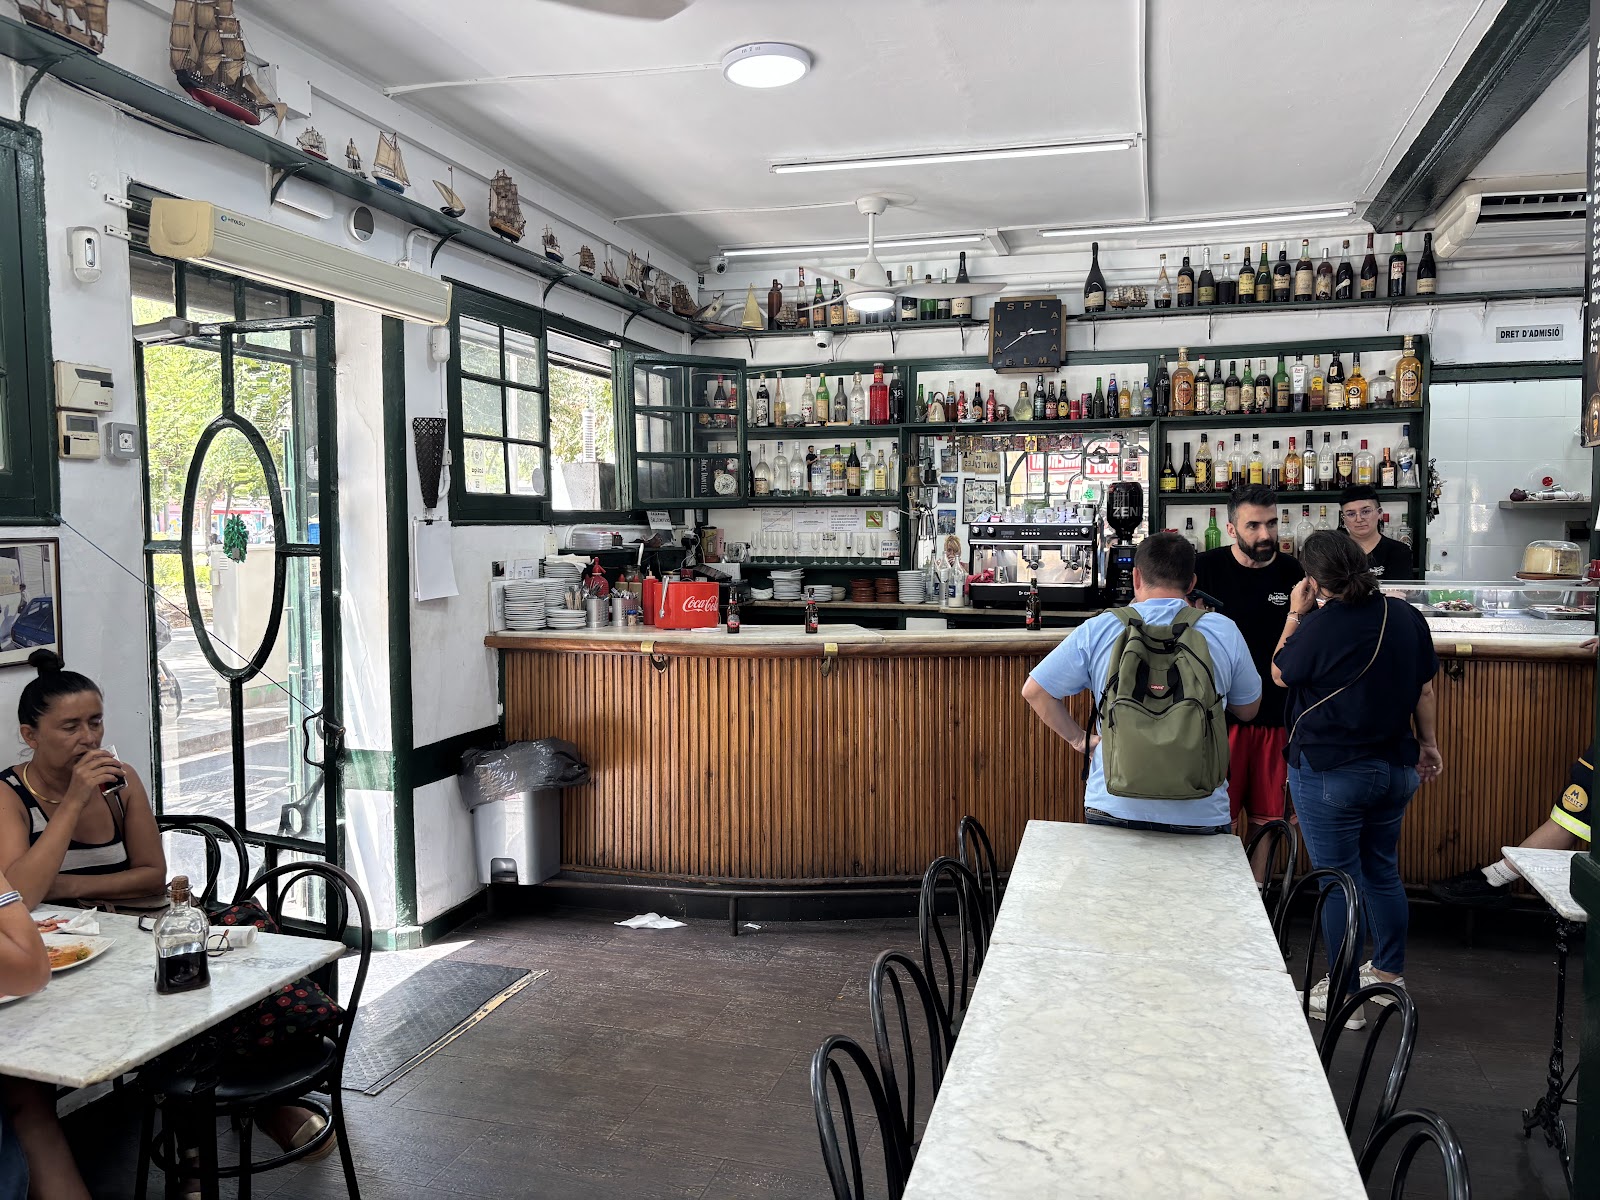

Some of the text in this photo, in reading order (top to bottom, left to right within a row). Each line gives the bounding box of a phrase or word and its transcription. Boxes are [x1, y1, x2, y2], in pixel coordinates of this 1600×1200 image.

[1500, 326, 1560, 339] DRET D'ADMISIÓ
[700, 458, 708, 472] JACK
[1564, 793, 1583, 808] MORITZ
[1571, 789, 1580, 799] M
